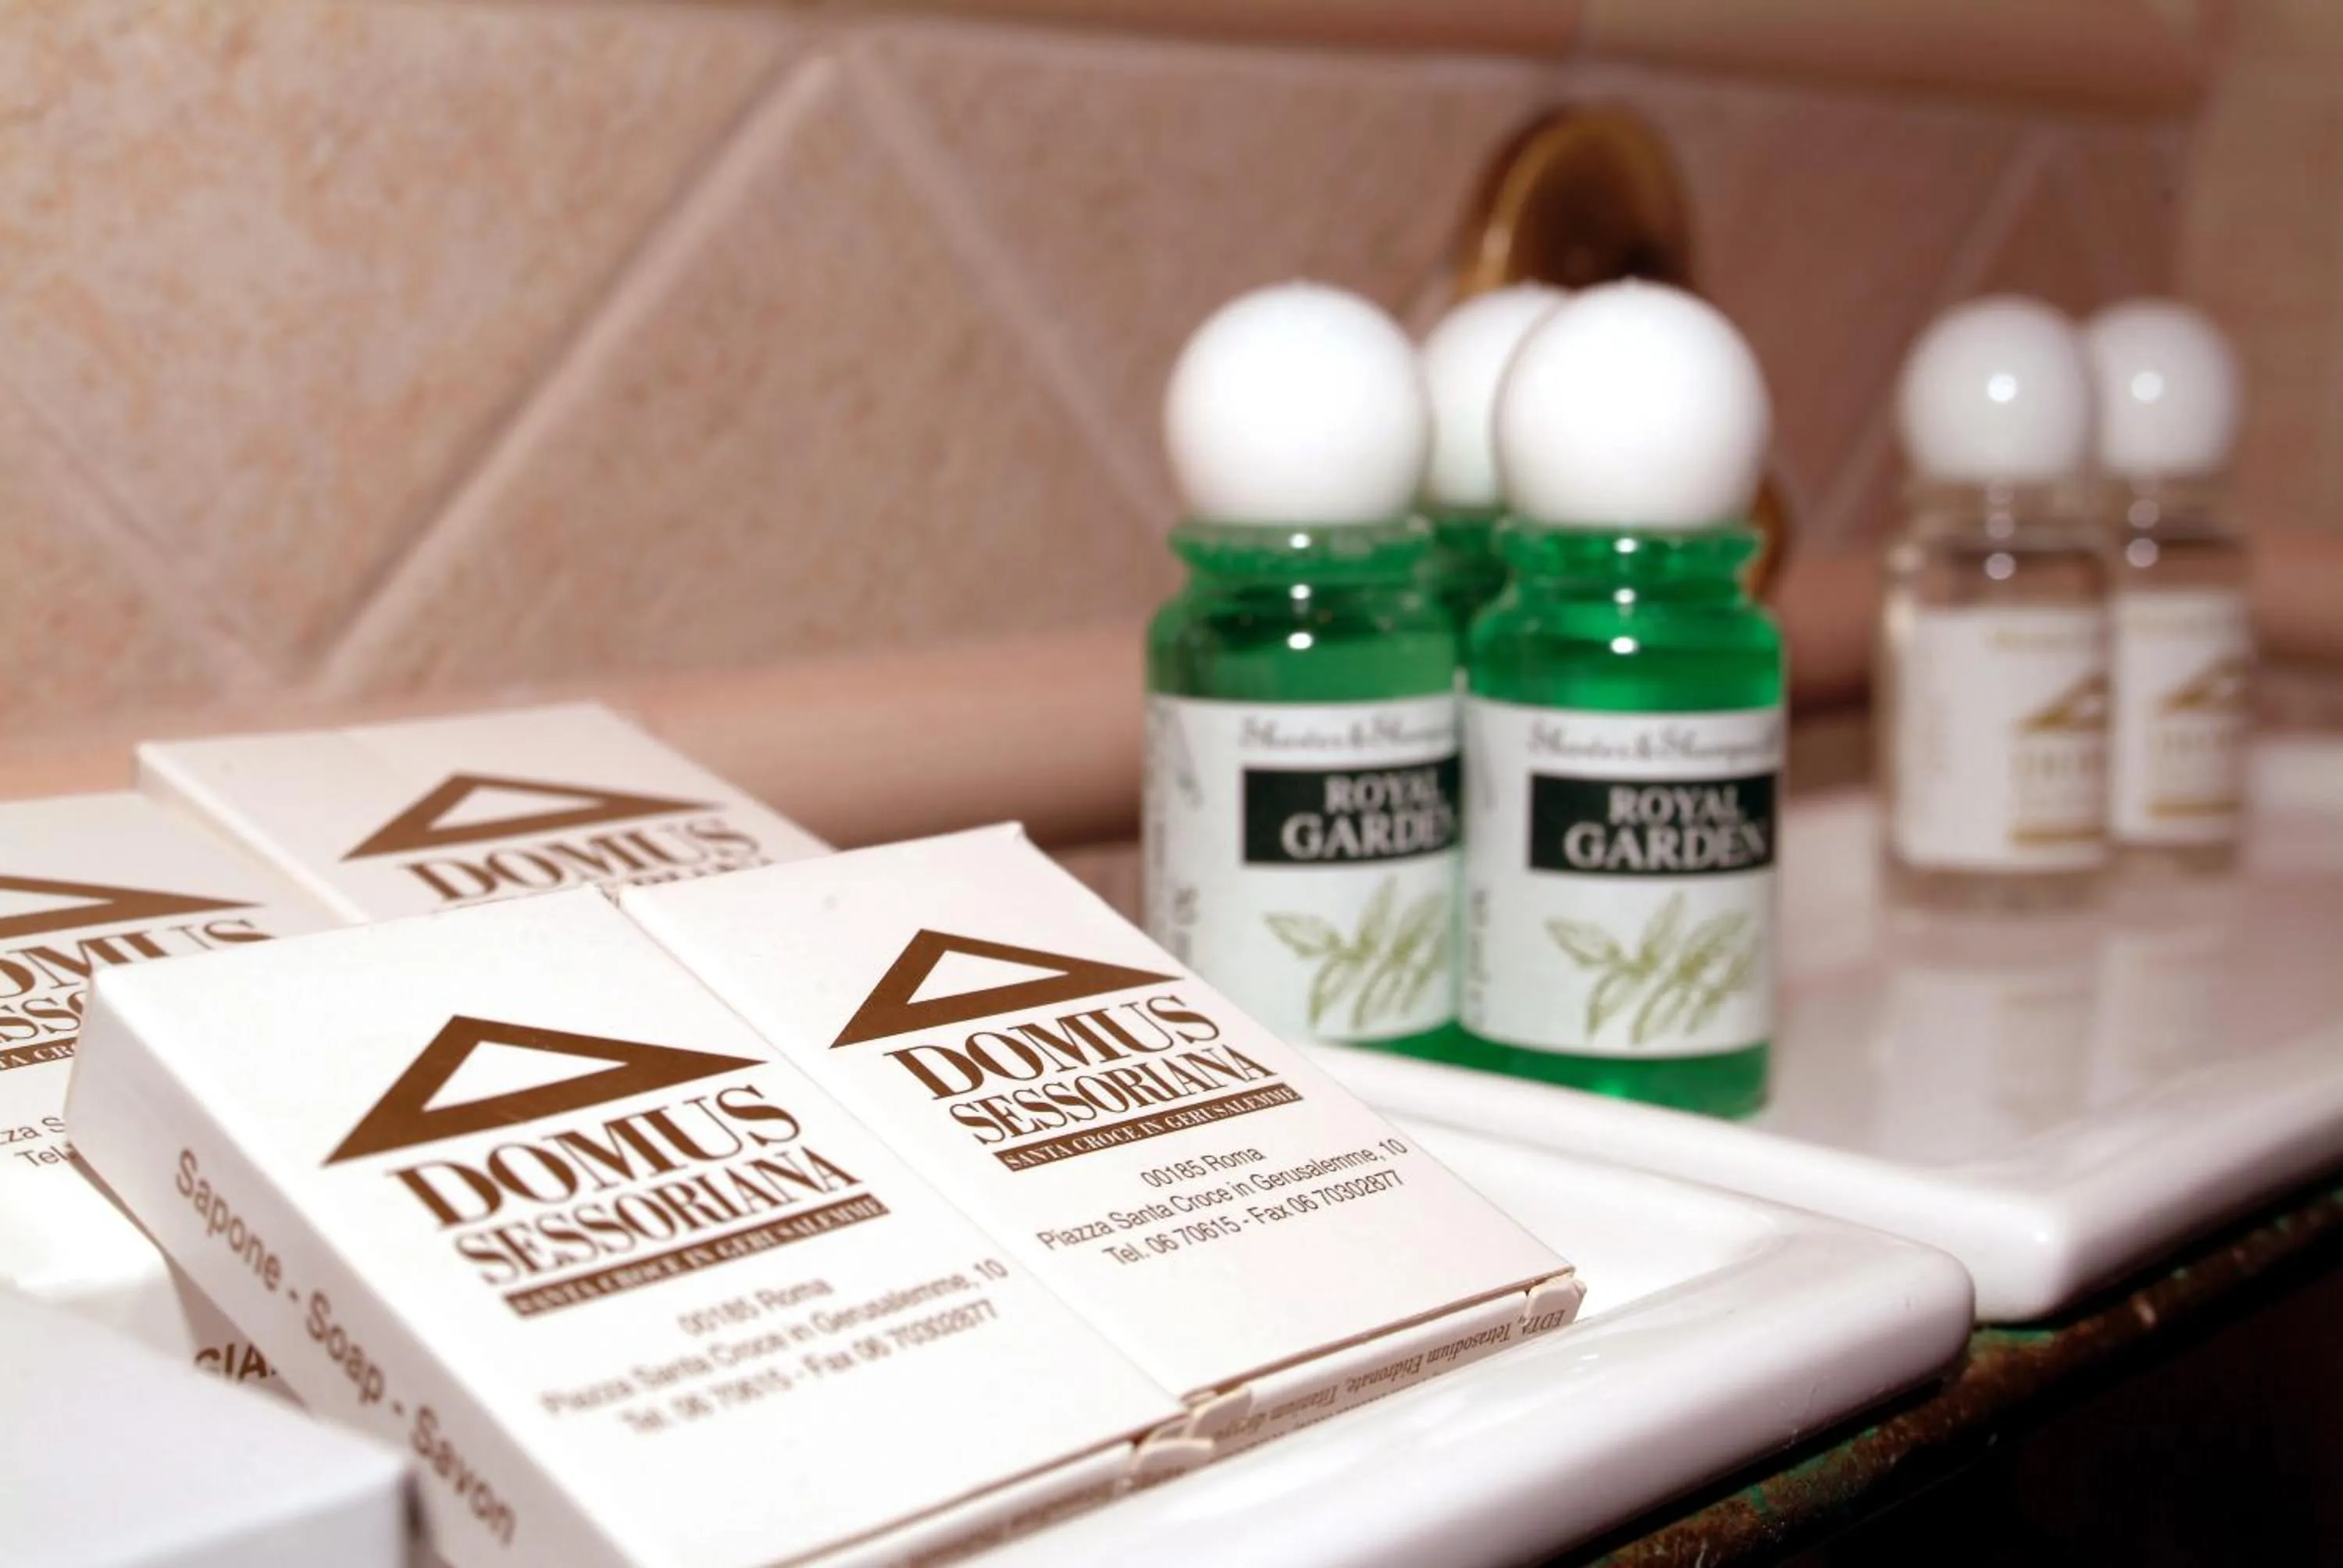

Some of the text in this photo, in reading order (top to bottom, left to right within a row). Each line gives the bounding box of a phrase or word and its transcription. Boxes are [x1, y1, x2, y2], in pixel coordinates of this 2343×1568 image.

[1324, 769, 1443, 814] ROYAL
[1609, 783, 1746, 826] ROYAL
[398, 817, 760, 907] DOMUS
[1564, 820, 1767, 870] GARDEN
[883, 995, 1220, 1101] DOMUS
[947, 1043, 1278, 1146] SESSORIANA
[1001, 1085, 1299, 1169] SANTA CROCE IN GERUSALEMME
[386, 1084, 801, 1231] DOMUS
[1036, 1138, 1408, 1251] Piazza Santa Croce in Gerusalemme, 10
[1139, 1146, 1266, 1189] 00185 Roma
[453, 1146, 863, 1285] SESSORIANA
[1103, 1239, 1150, 1266] Tel.
[1151, 1231, 1181, 1255] 06
[1173, 1214, 1242, 1247] 70615
[1247, 1203, 1289, 1226] Fax
[1285, 1192, 1318, 1215] 06
[1311, 1170, 1407, 1208] 70302877
[973, 1259, 1009, 1281] 10
[175, 1148, 283, 1292] Sapone
[306, 1291, 386, 1406] Soap
[408, 1404, 518, 1548] Savon
[1426, 1323, 1512, 1363] Tetrasodium
